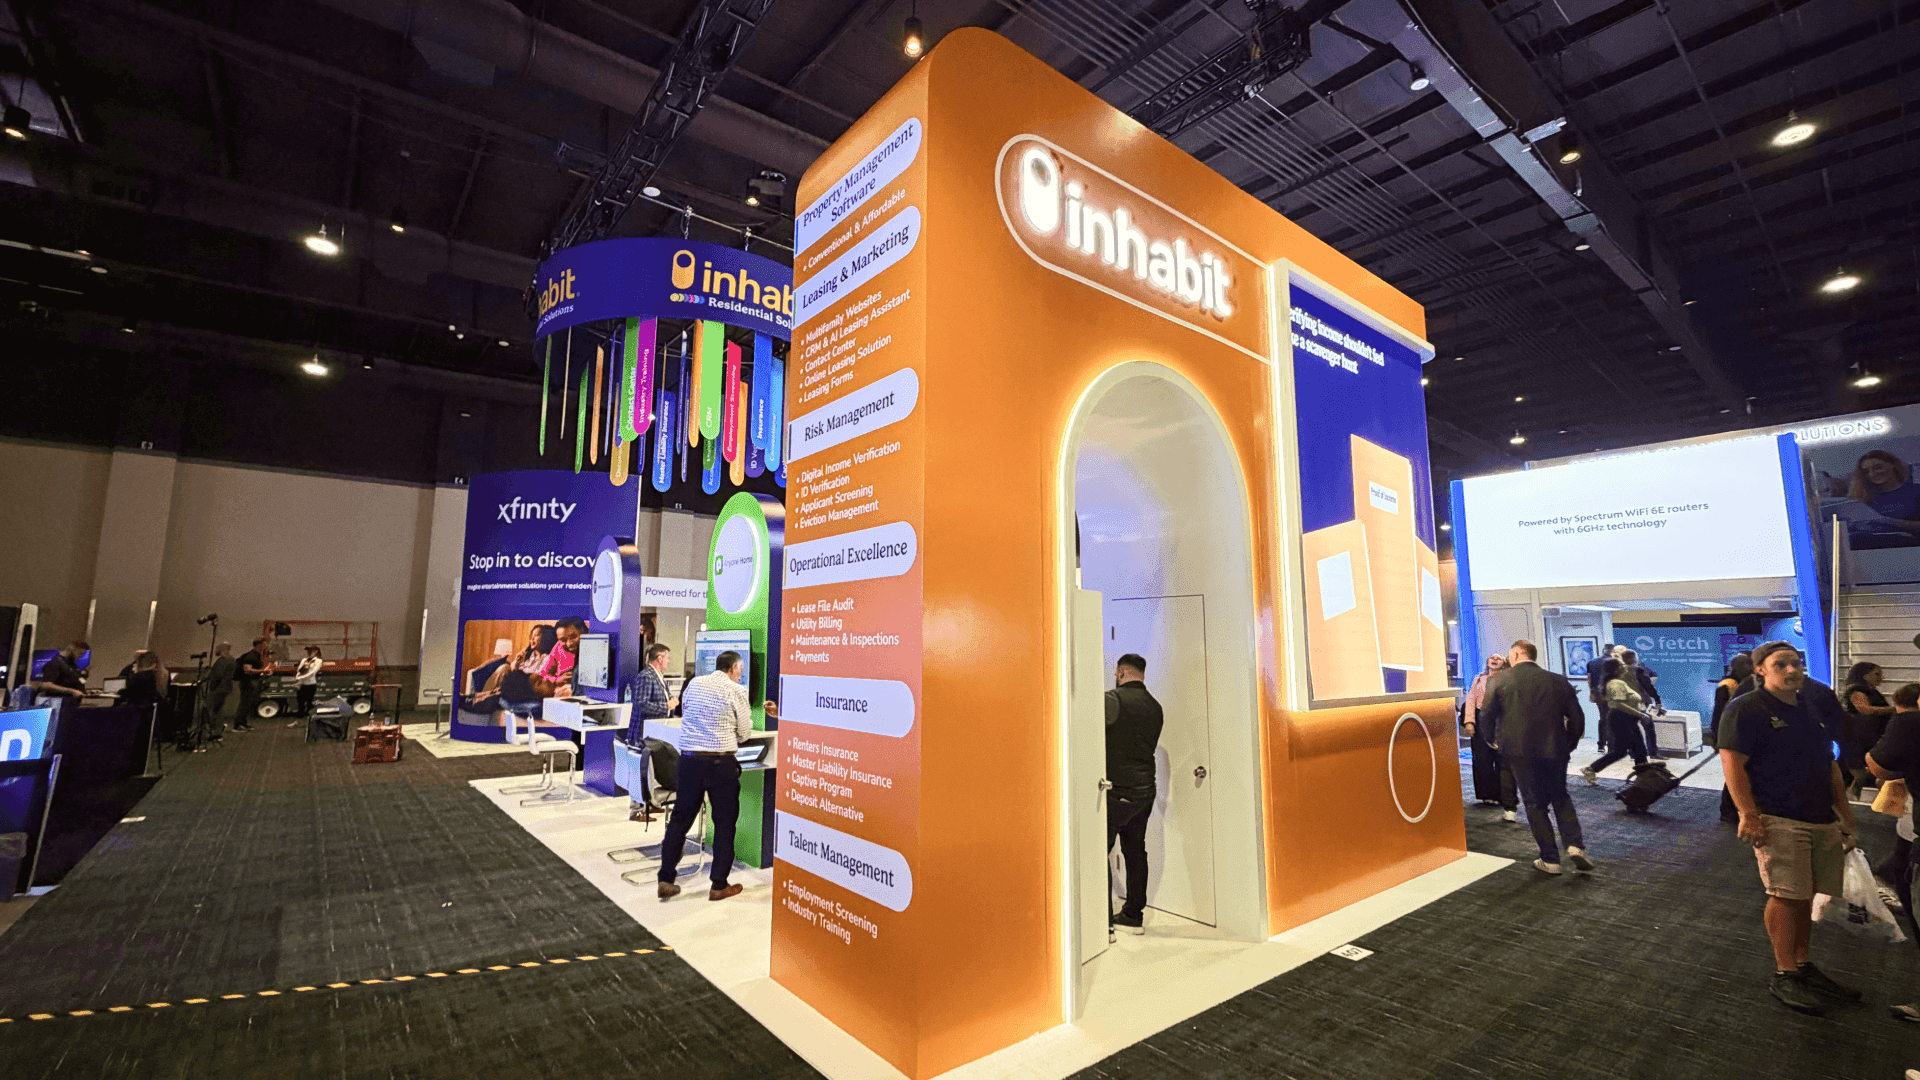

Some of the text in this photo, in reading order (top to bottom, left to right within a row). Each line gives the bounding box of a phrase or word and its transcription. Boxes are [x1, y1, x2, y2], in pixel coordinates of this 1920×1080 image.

[803, 123, 914, 227] Property Management
[831, 177, 876, 222] Software
[808, 188, 906, 268] Conventional & Affordable
[1064, 180, 1232, 319] inhabit
[802, 224, 910, 309] Leasing & Marketing
[708, 297, 773, 322] Residential
[805, 290, 882, 344] Multifamily Websites
[805, 288, 911, 358] CRM & AI Leasing Assistant
[804, 334, 892, 387] Online Leasing Solution
[805, 337, 857, 373] Contact Center
[803, 370, 854, 403] Leasing Forms
[804, 391, 895, 442] Risk Management
[1794, 419, 1884, 441] LUTIONS
[801, 440, 901, 484] Digital Income Verification
[800, 483, 874, 515] Applicant Screening
[801, 474, 850, 498] ID Verification
[497, 496, 578, 524] xfinity
[800, 499, 880, 529] Eviction Management
[1518, 502, 1710, 528] Powered by Spectrum WiFi 6E routers
[1553, 518, 1668, 535] with 6GHz technology
[469, 553, 494, 573] Stop
[495, 551, 510, 568] in
[514, 553, 533, 568] to
[789, 541, 908, 576] Operational Excellence
[518, 582, 547, 590] solutions
[547, 583, 565, 591] your
[645, 587, 687, 598] Powered
[688, 589, 702, 598] for
[796, 597, 854, 614] Lease File Audit
[796, 615, 843, 631] Utility Billing
[795, 632, 900, 648] Maintenance & Inspections
[1658, 636, 1709, 650] fetch
[795, 650, 830, 664] Payments
[815, 691, 868, 713] Insurance
[792, 736, 859, 762] Renters Insurance
[791, 770, 853, 799] Captive Program
[792, 754, 893, 789] Master Liability Insurance
[791, 788, 864, 823] Deposit Alternative
[788, 830, 895, 888] Talent Management
[787, 896, 851, 945] Industry Training
[788, 879, 878, 939] Employment Screening
